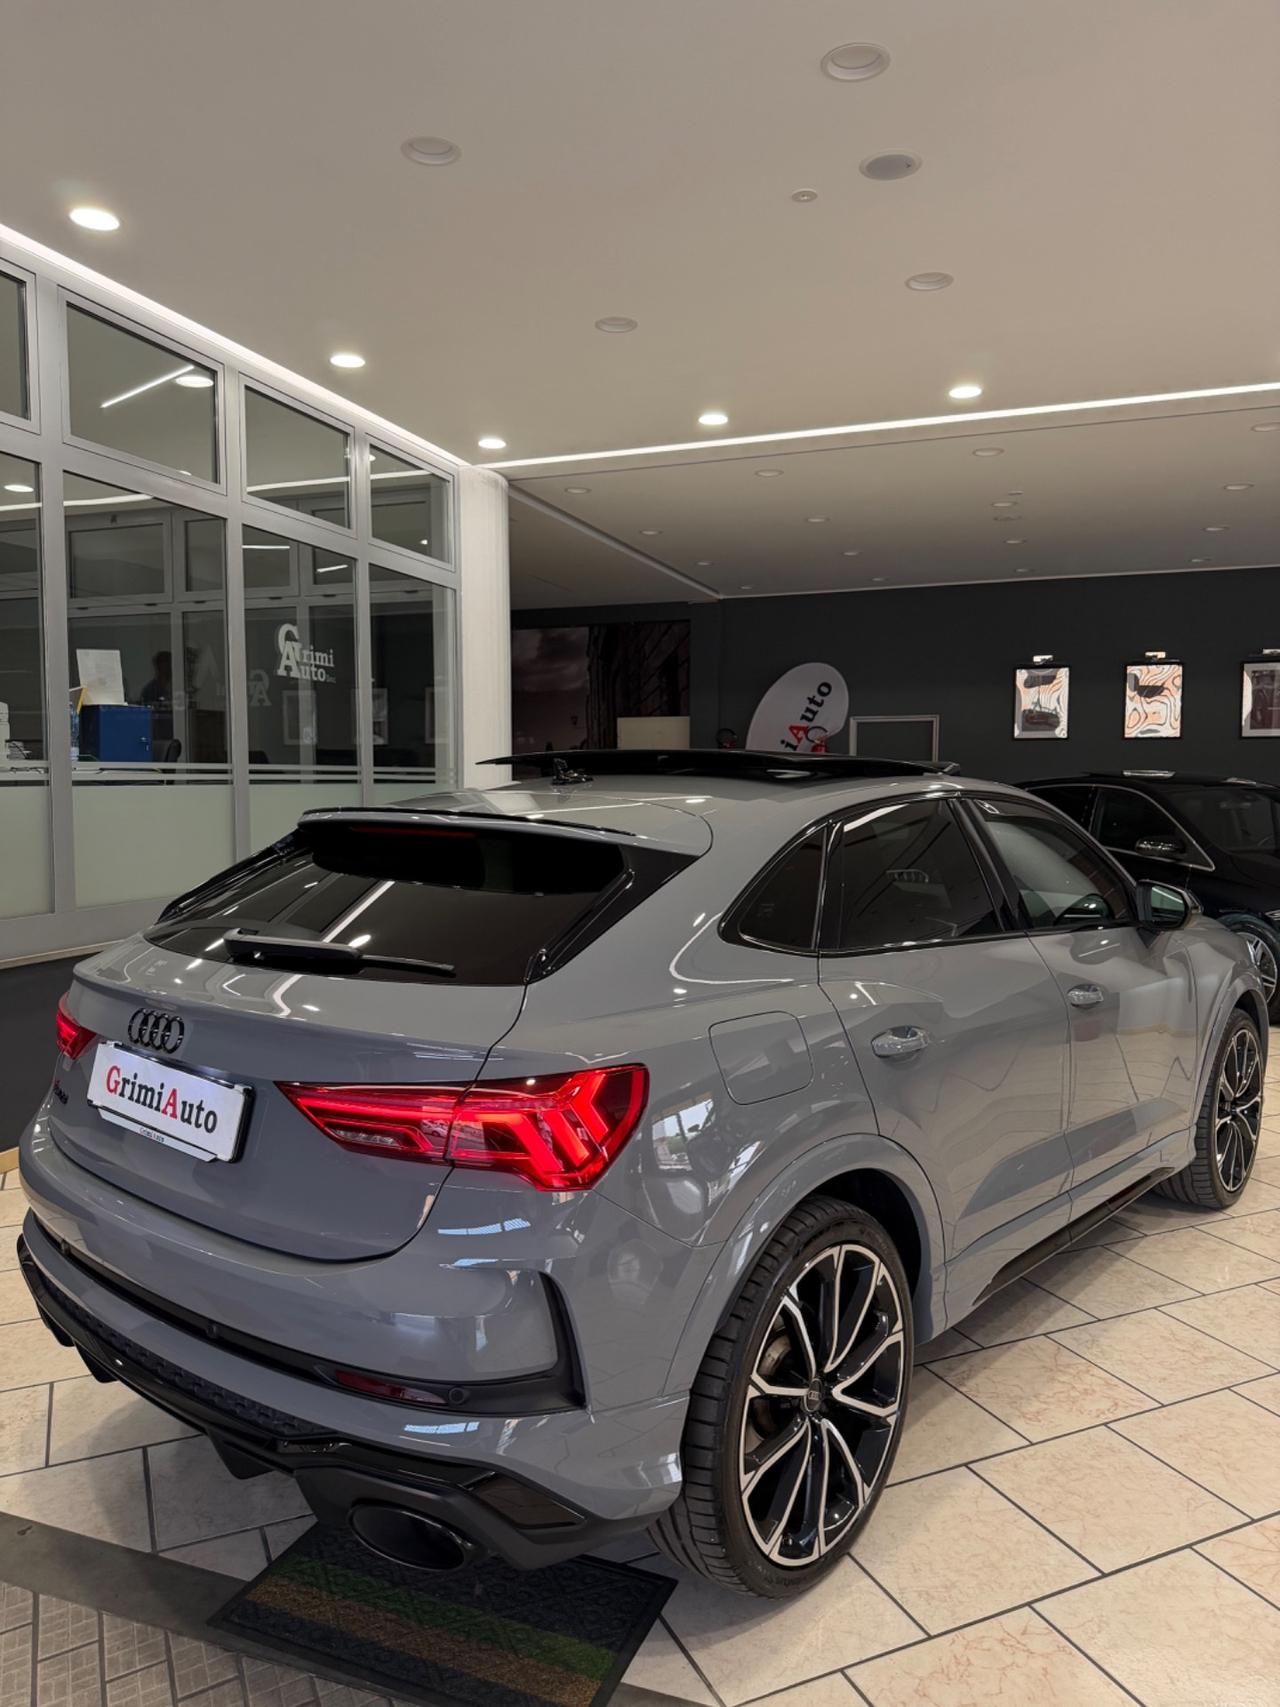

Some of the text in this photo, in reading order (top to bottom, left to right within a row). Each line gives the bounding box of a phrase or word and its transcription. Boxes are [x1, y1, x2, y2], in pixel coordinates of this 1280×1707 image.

[277, 640, 326, 682] Auto
[278, 623, 335, 667] Grimi
[780, 682, 833, 752] iAuto
[106, 1065, 218, 1134] GrimiAuto
